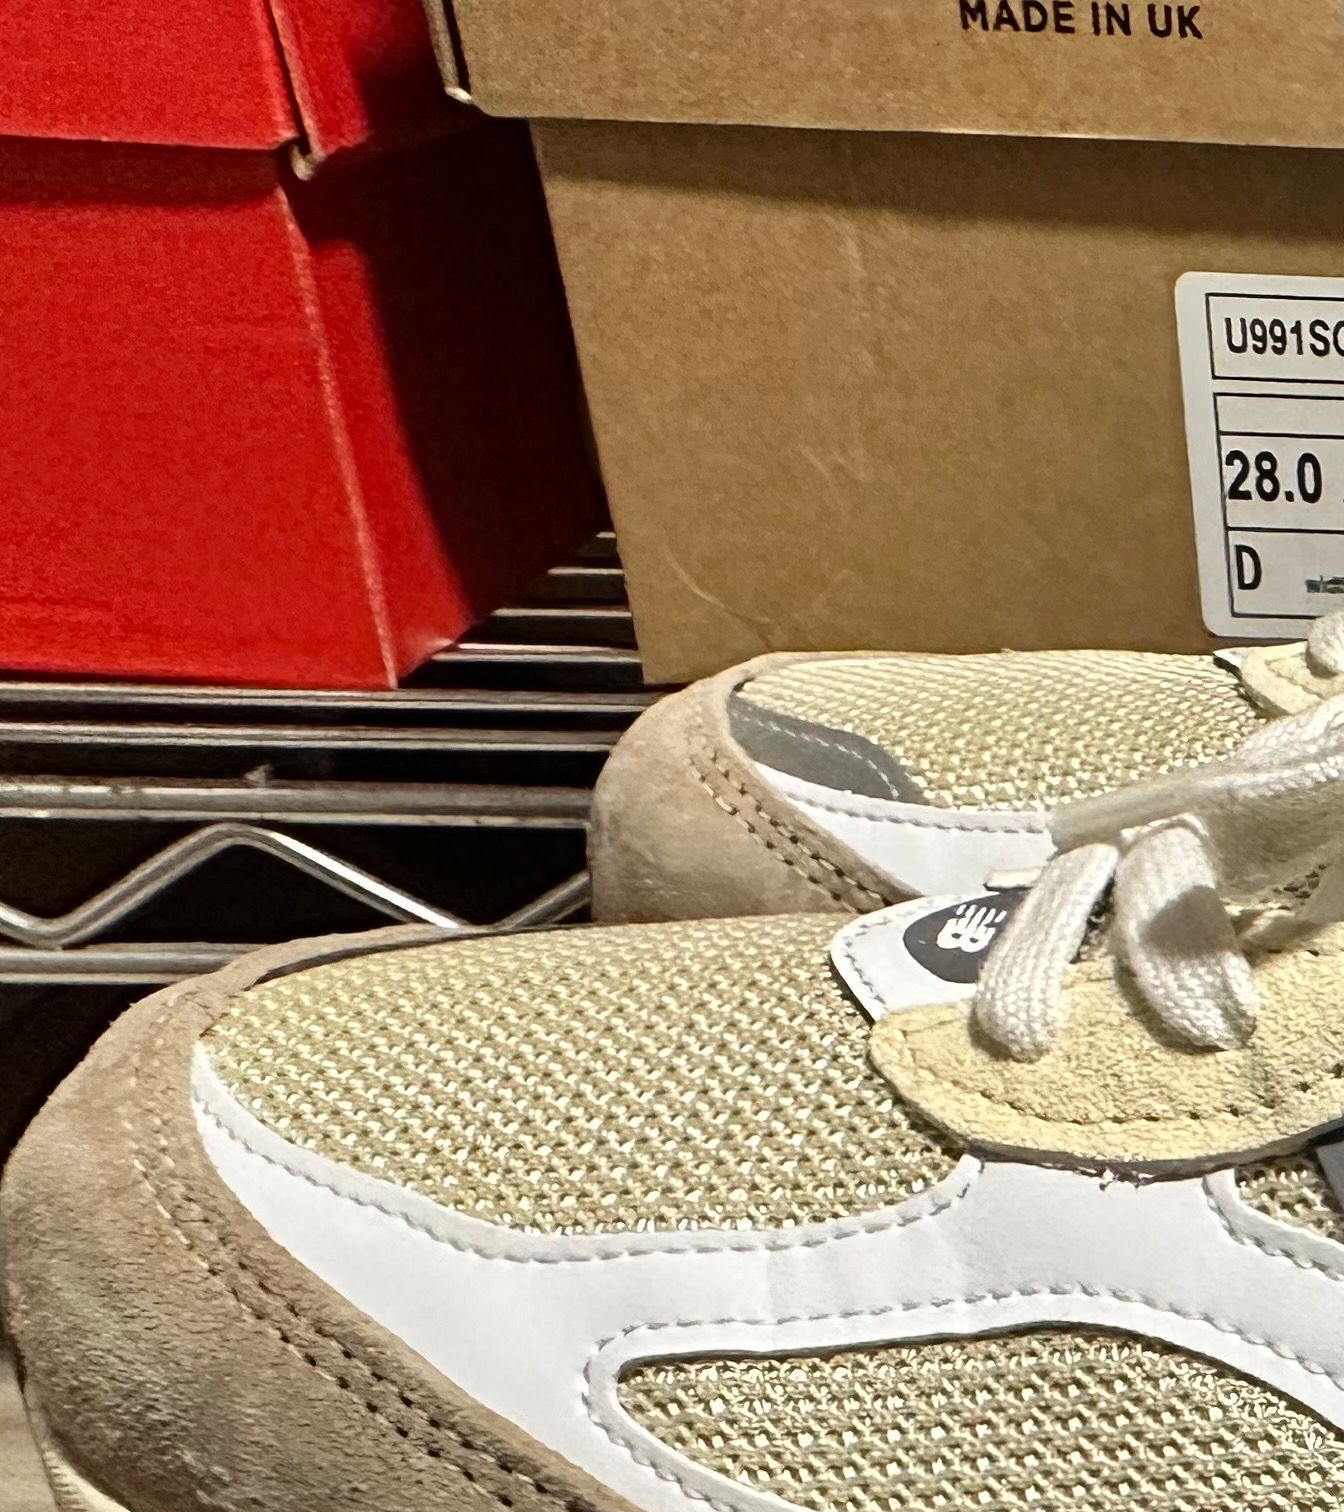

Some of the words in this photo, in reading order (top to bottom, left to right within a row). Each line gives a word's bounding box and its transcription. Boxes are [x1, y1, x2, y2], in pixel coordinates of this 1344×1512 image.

[959, 0, 1075, 34] MADE
[1091, 2, 1131, 36] IN
[1147, 4, 1203, 39] UK
[1225, 449, 1323, 504] 28.0
[1235, 545, 1263, 591] D
